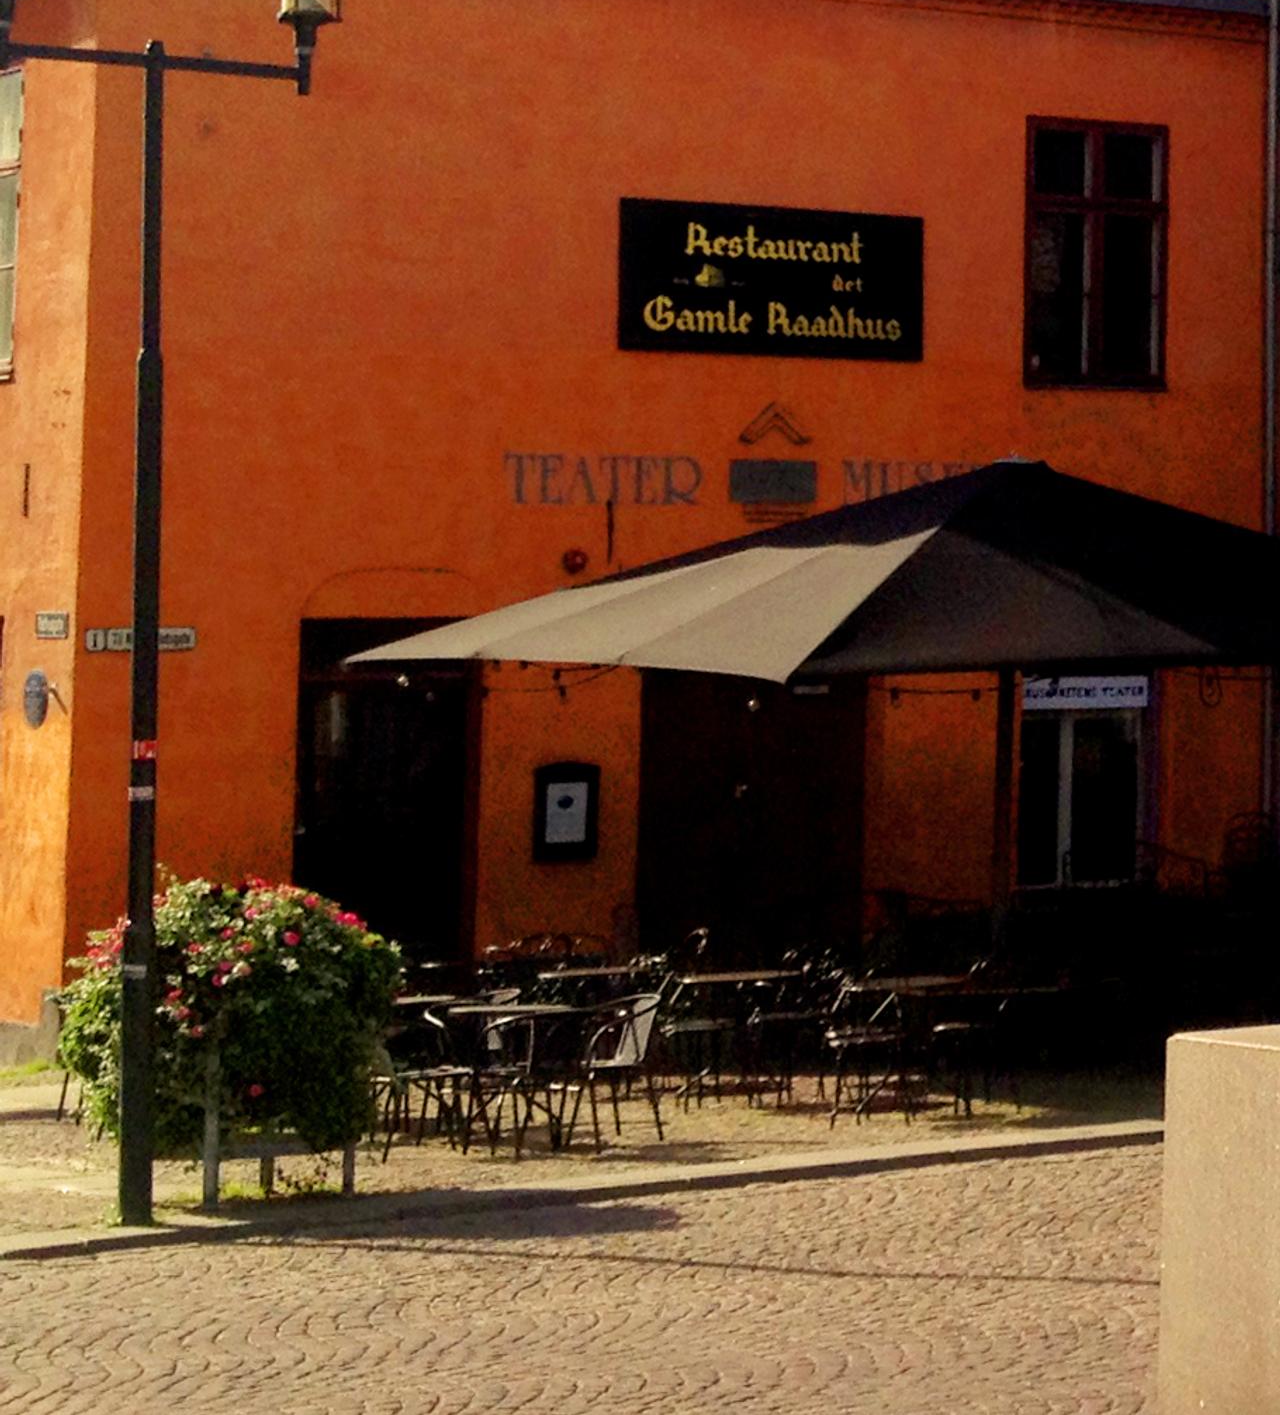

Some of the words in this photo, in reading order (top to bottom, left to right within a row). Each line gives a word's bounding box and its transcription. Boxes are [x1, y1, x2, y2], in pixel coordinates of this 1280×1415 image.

[684, 221, 865, 265] Restaurant
[831, 274, 864, 293] det
[643, 294, 754, 334] Gamle
[766, 300, 903, 342] Raadhus
[503, 452, 702, 506] TEATER
